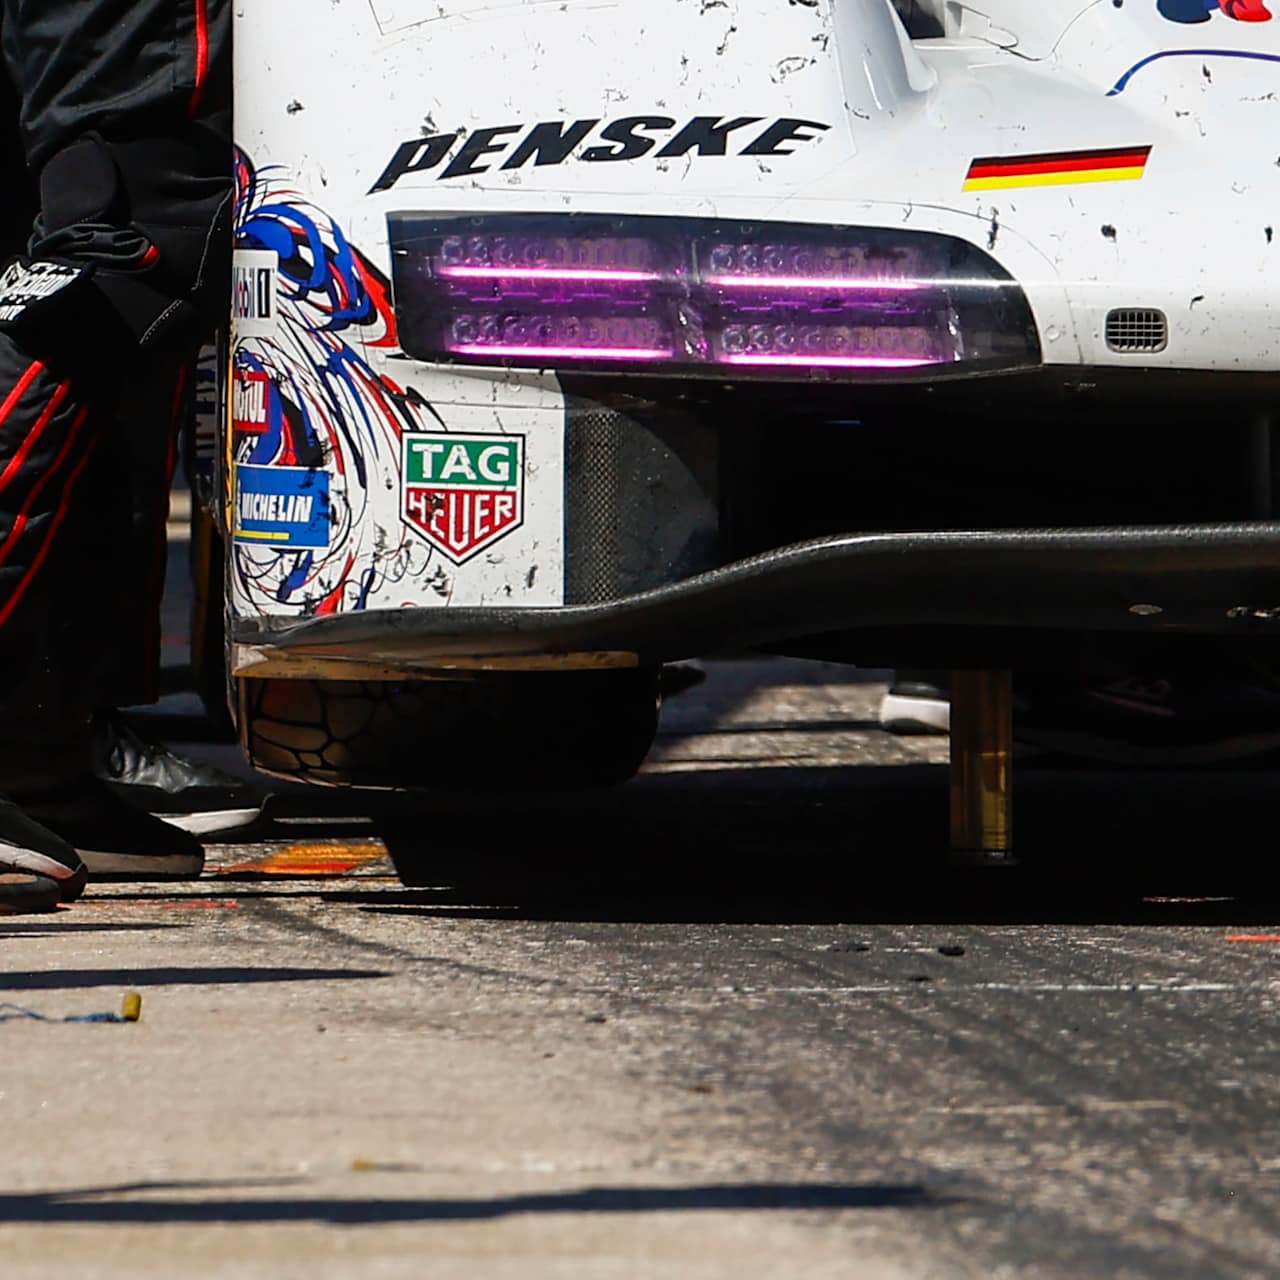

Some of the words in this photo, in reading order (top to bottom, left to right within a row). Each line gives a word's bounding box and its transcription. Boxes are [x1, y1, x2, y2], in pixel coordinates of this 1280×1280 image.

[366, 115, 834, 196] PENSKE
[411, 443, 511, 482] TAG
[242, 492, 313, 523] MICHELIN
[408, 490, 514, 552] HEUER
